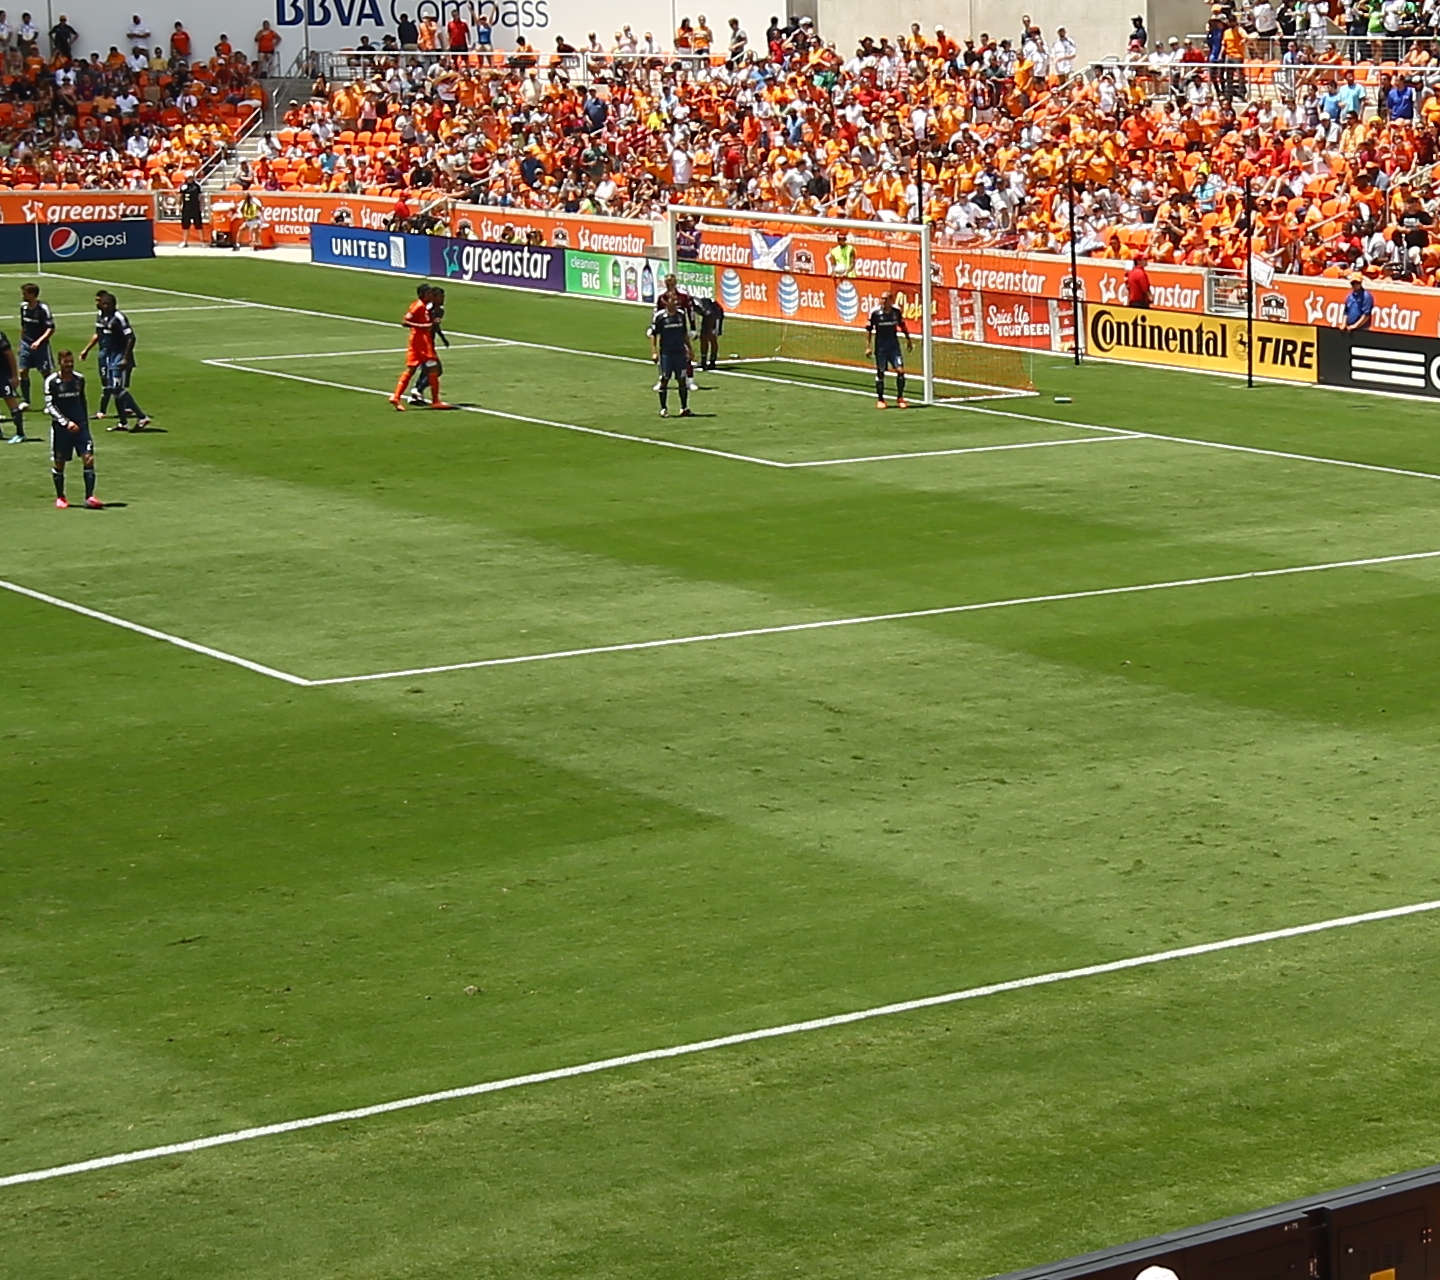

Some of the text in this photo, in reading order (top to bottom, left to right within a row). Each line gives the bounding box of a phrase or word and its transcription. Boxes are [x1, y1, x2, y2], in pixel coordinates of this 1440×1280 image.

[82, 231, 127, 250] pepsi
[332, 238, 388, 260] UNITED
[590, 233, 645, 253] greenstar
[462, 245, 551, 281] greenstar
[699, 240, 750, 265] reenstar
[570, 257, 600, 271] cleaning
[856, 257, 907, 280] eenstar
[582, 272, 600, 290] BIG
[972, 269, 1047, 295] greenstar
[744, 283, 767, 303] at&t
[801, 289, 825, 309] at&t
[987, 303, 1031, 326] Spice Up
[1326, 303, 1420, 331] grnstar
[997, 324, 1024, 336] YOUR
[1024, 323, 1050, 336] BEER
[1091, 309, 1228, 358] Continental
[1257, 336, 1314, 369] TIRE
